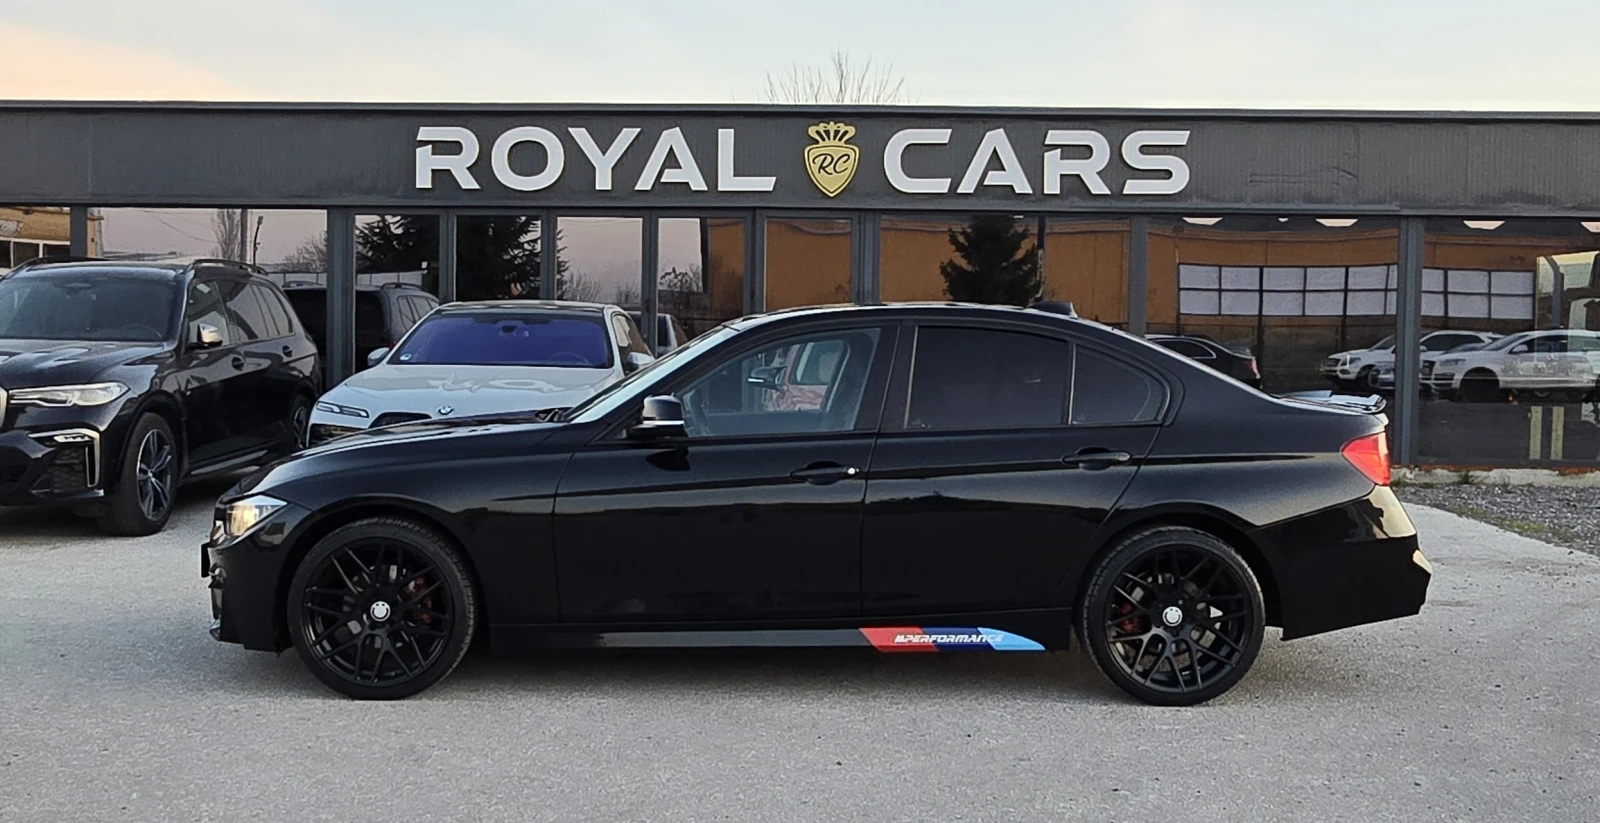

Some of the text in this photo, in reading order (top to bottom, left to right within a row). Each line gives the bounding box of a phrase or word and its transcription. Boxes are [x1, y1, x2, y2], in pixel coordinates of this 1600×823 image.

[415, 126, 1191, 195] ROYAL CARS
[812, 152, 851, 176] RC
